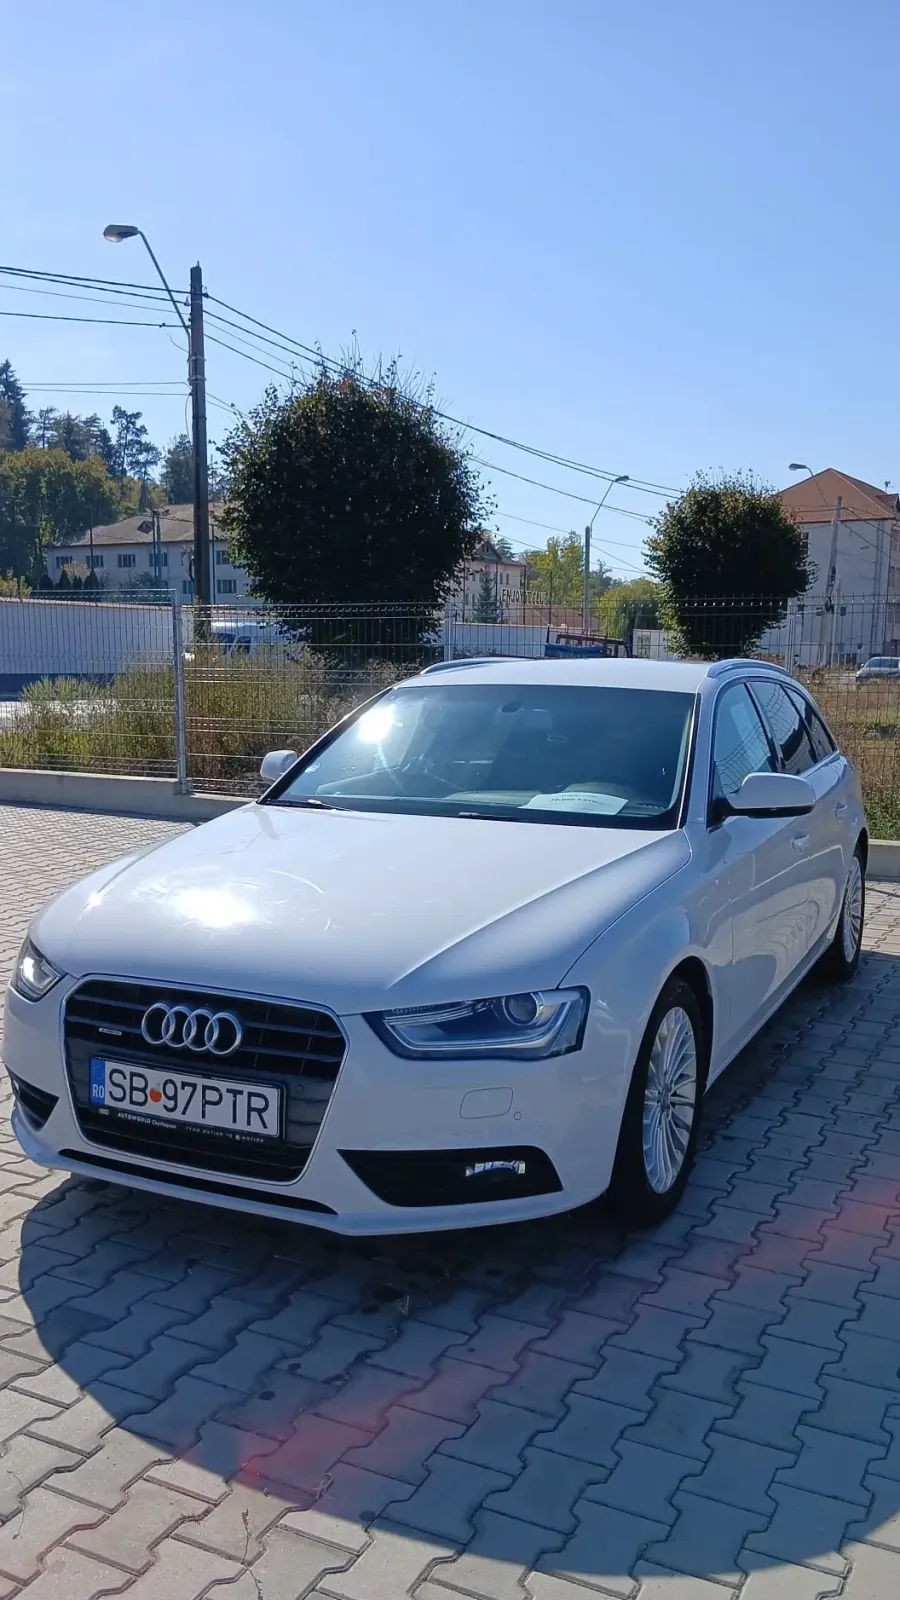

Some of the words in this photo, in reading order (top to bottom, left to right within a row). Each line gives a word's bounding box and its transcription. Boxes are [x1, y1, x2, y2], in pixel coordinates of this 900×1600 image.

[92, 1083, 104, 1099] RO
[108, 1068, 149, 1107] SB
[117, 1112, 151, 1124] AUTOWORLD
